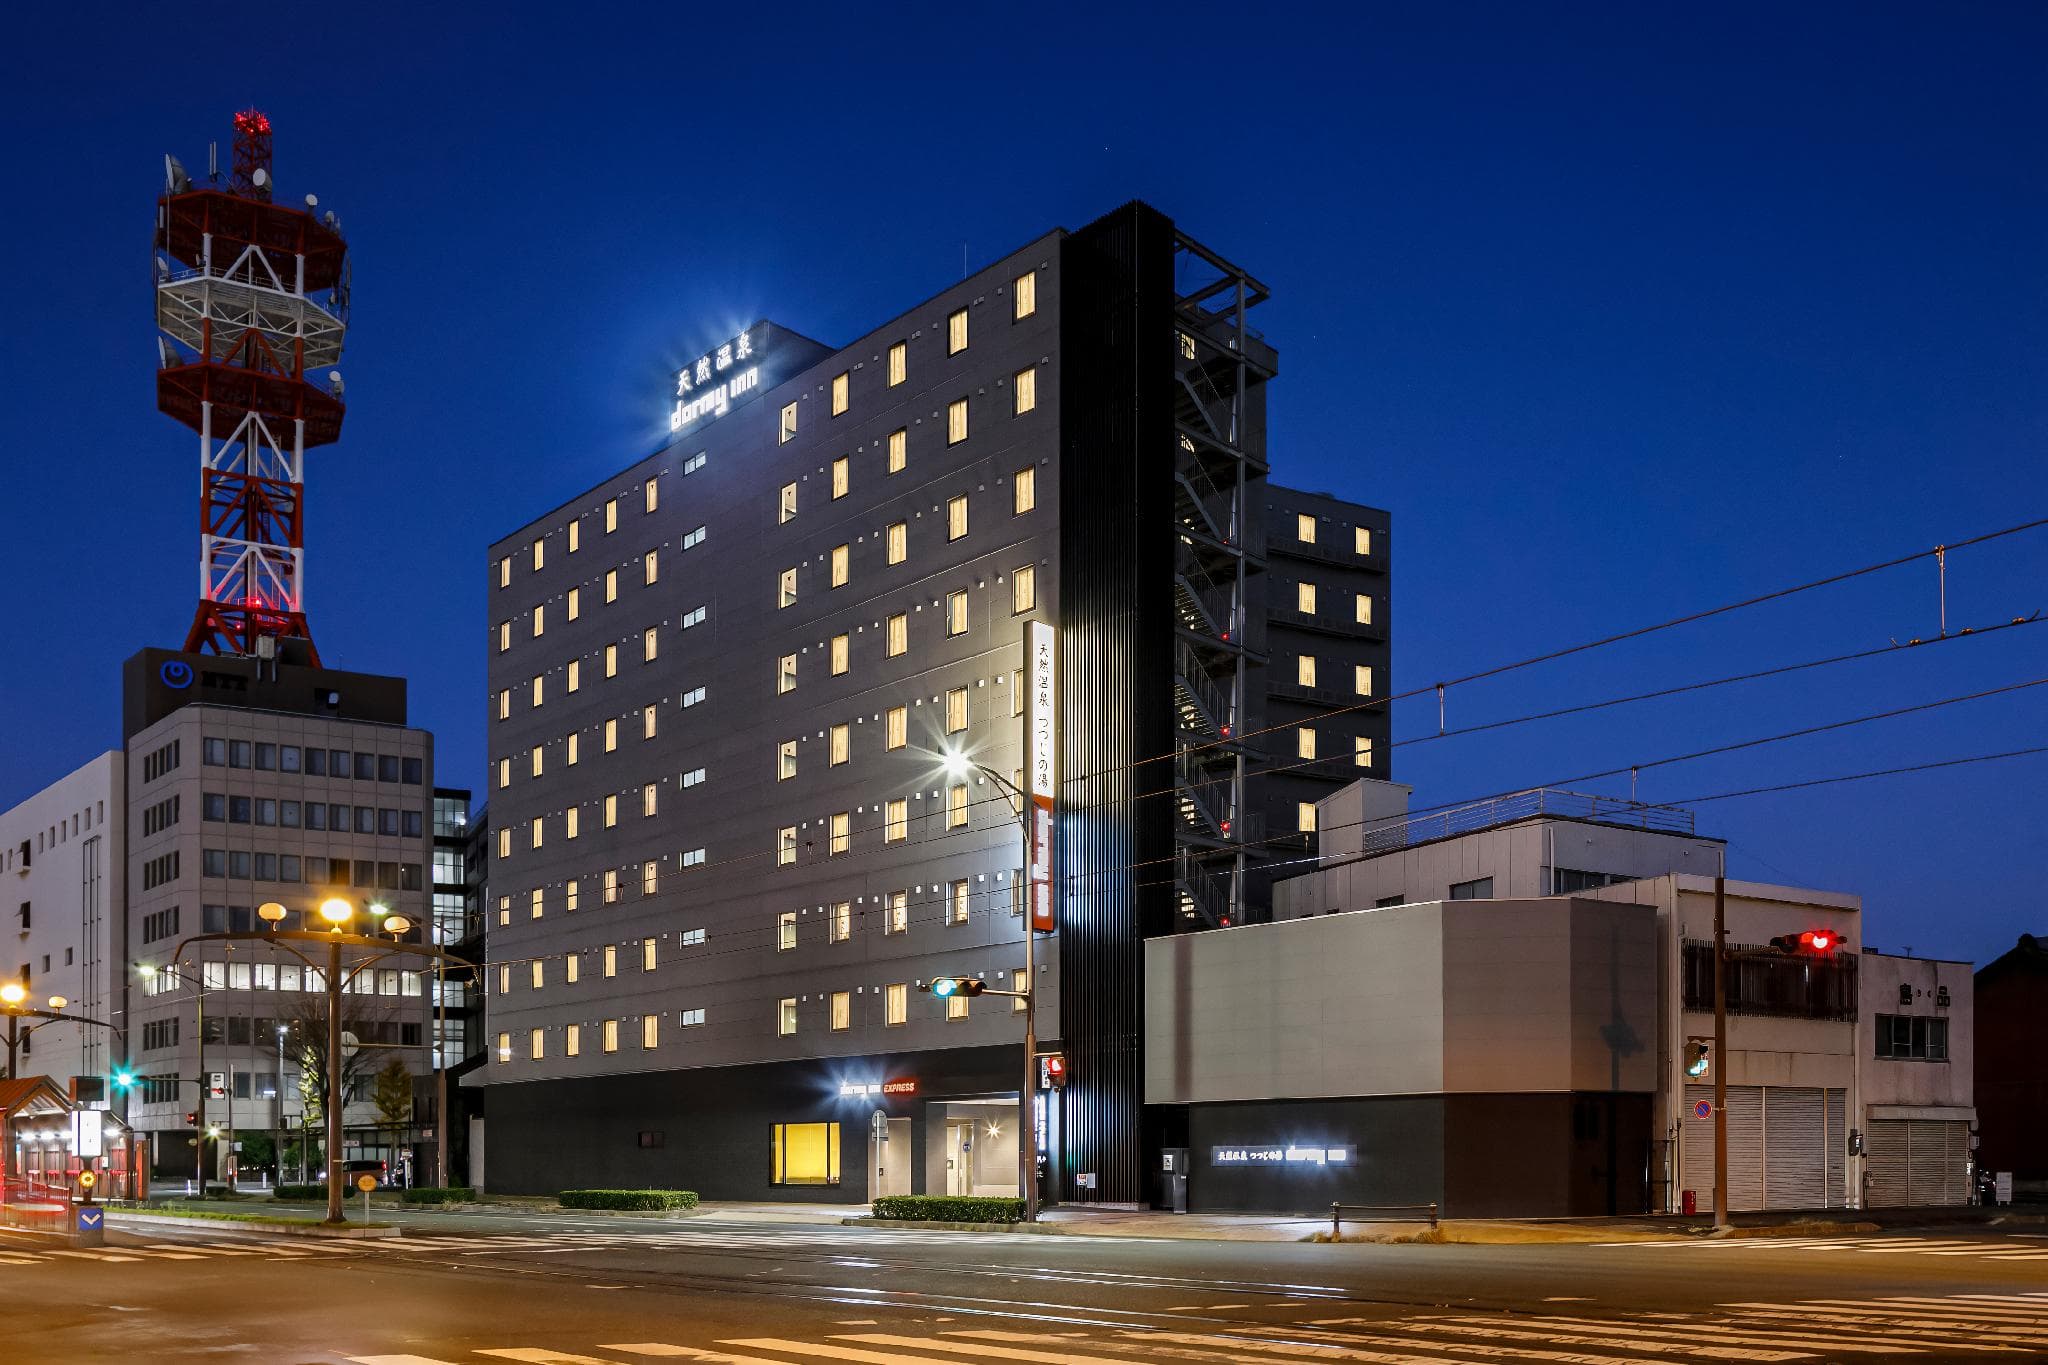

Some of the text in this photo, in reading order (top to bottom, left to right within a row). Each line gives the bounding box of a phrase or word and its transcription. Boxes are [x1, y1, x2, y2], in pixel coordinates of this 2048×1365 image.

[677, 331, 752, 396] 天然温泉
[671, 367, 758, 431] dormy inn
[1038, 644, 1049, 707] 天然温泉
[883, 1082, 915, 1093] EXPRESS
